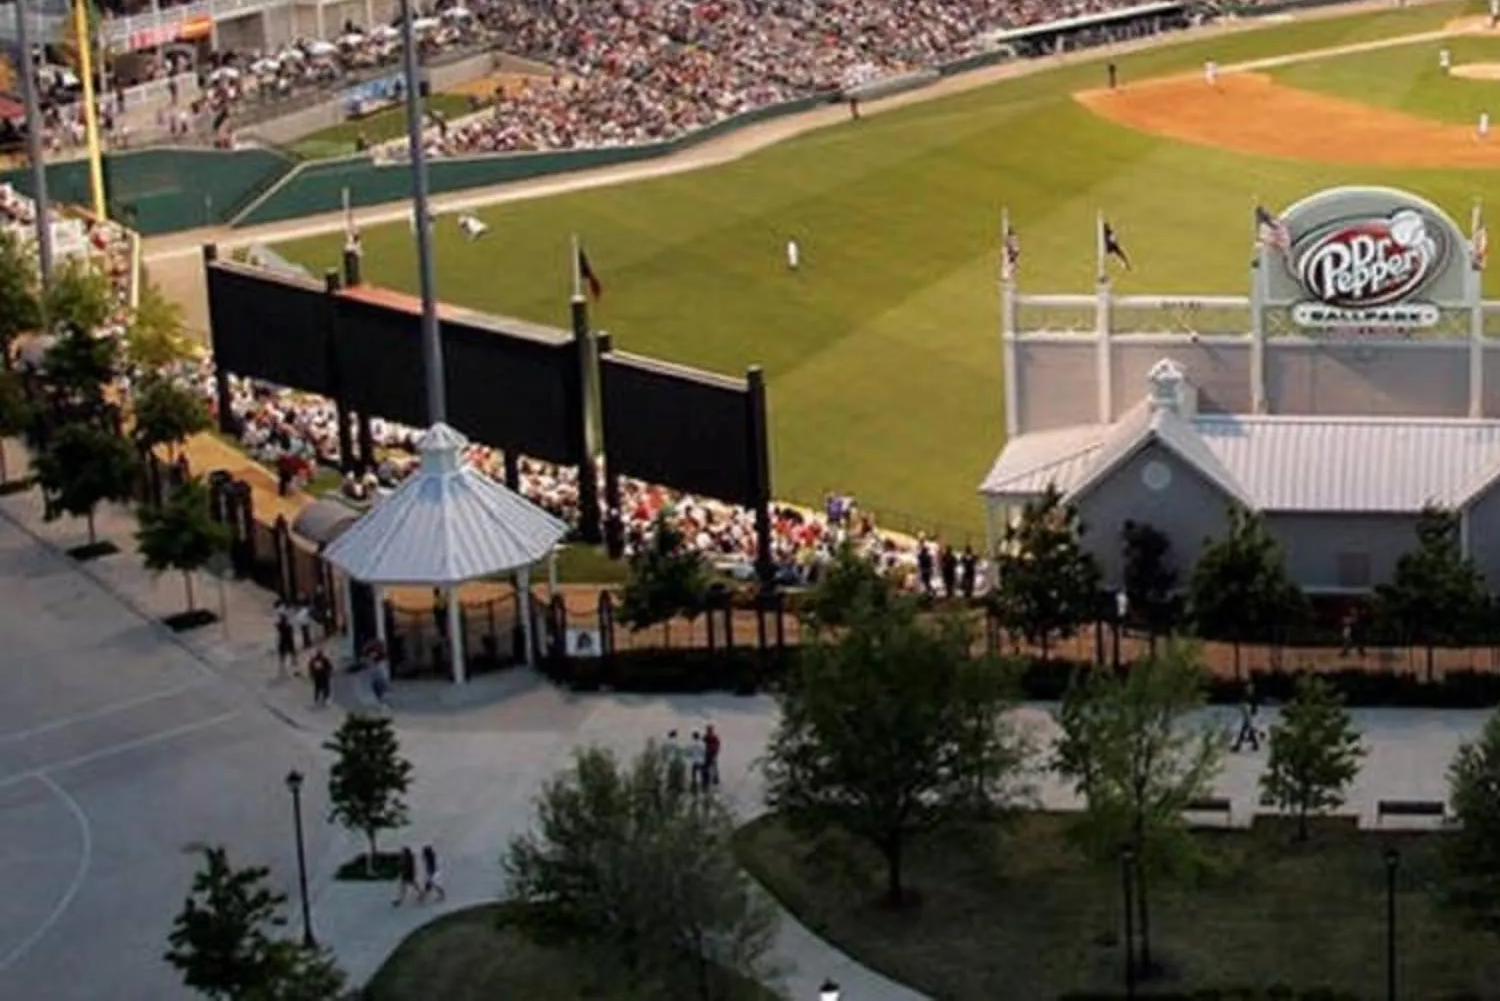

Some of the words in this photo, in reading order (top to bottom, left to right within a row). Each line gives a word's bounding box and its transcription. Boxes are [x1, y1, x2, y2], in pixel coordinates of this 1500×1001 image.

[1350, 234, 1392, 265] Dr
[1312, 241, 1419, 299] Pepper
[1309, 309, 1420, 321] BALLPARK
